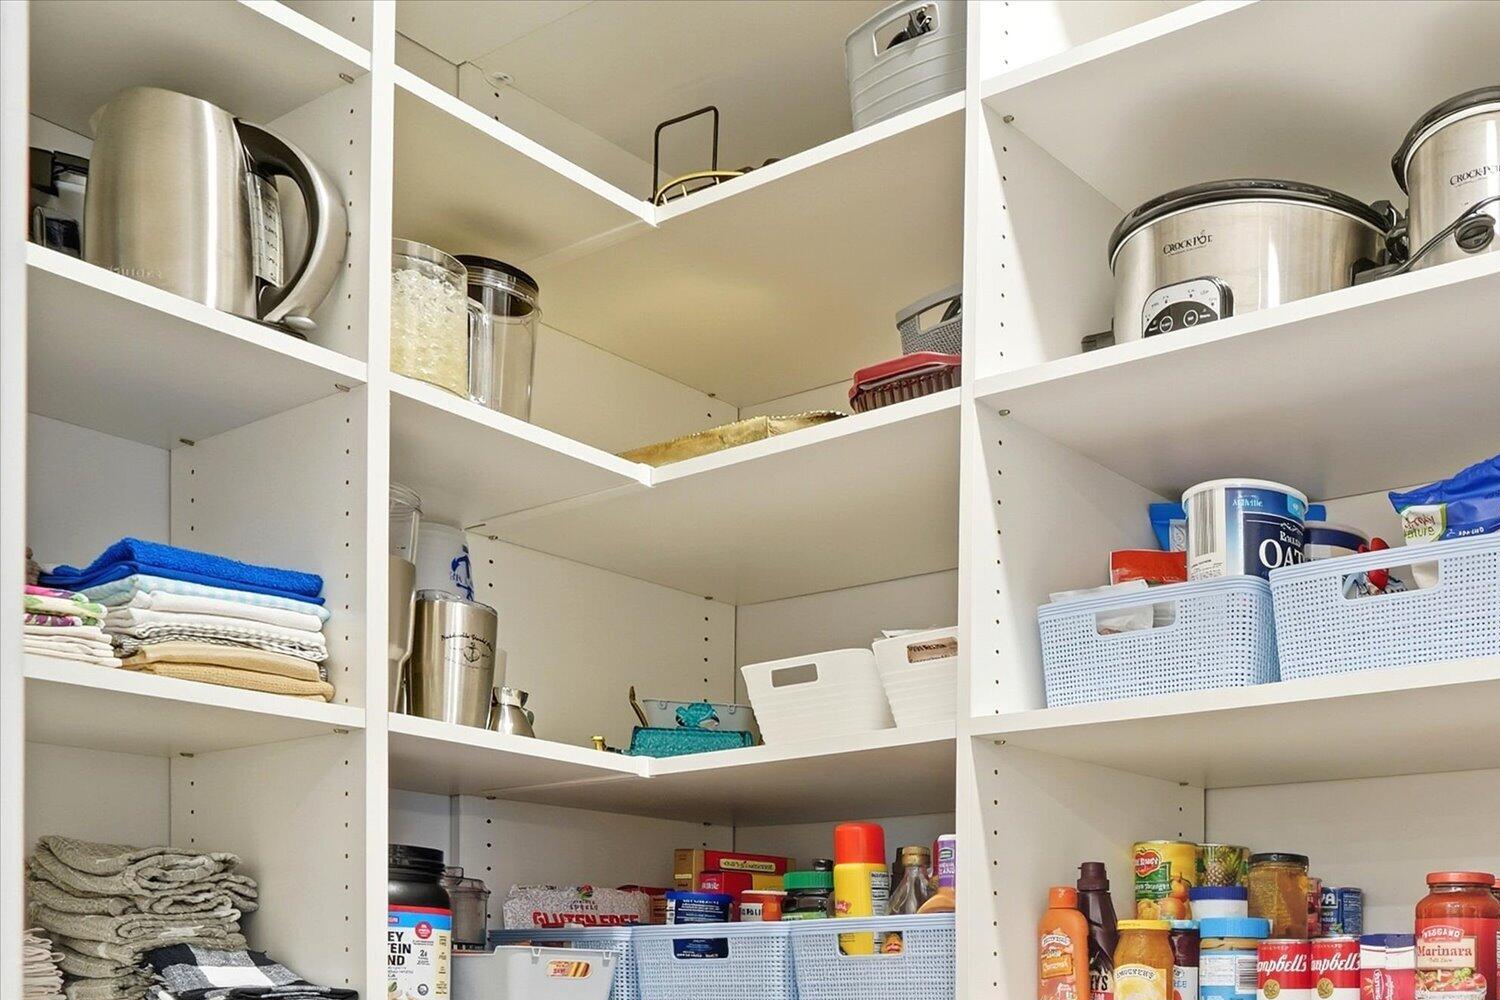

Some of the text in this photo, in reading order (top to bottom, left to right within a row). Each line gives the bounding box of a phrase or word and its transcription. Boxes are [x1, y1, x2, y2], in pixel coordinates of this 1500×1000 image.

[1259, 538, 1304, 569] OAT
[532, 911, 597, 928] GLUTEN
[1311, 951, 1360, 976] ampbell's
[1417, 945, 1472, 958] Marinara
[1257, 952, 1307, 977] ampbell's
